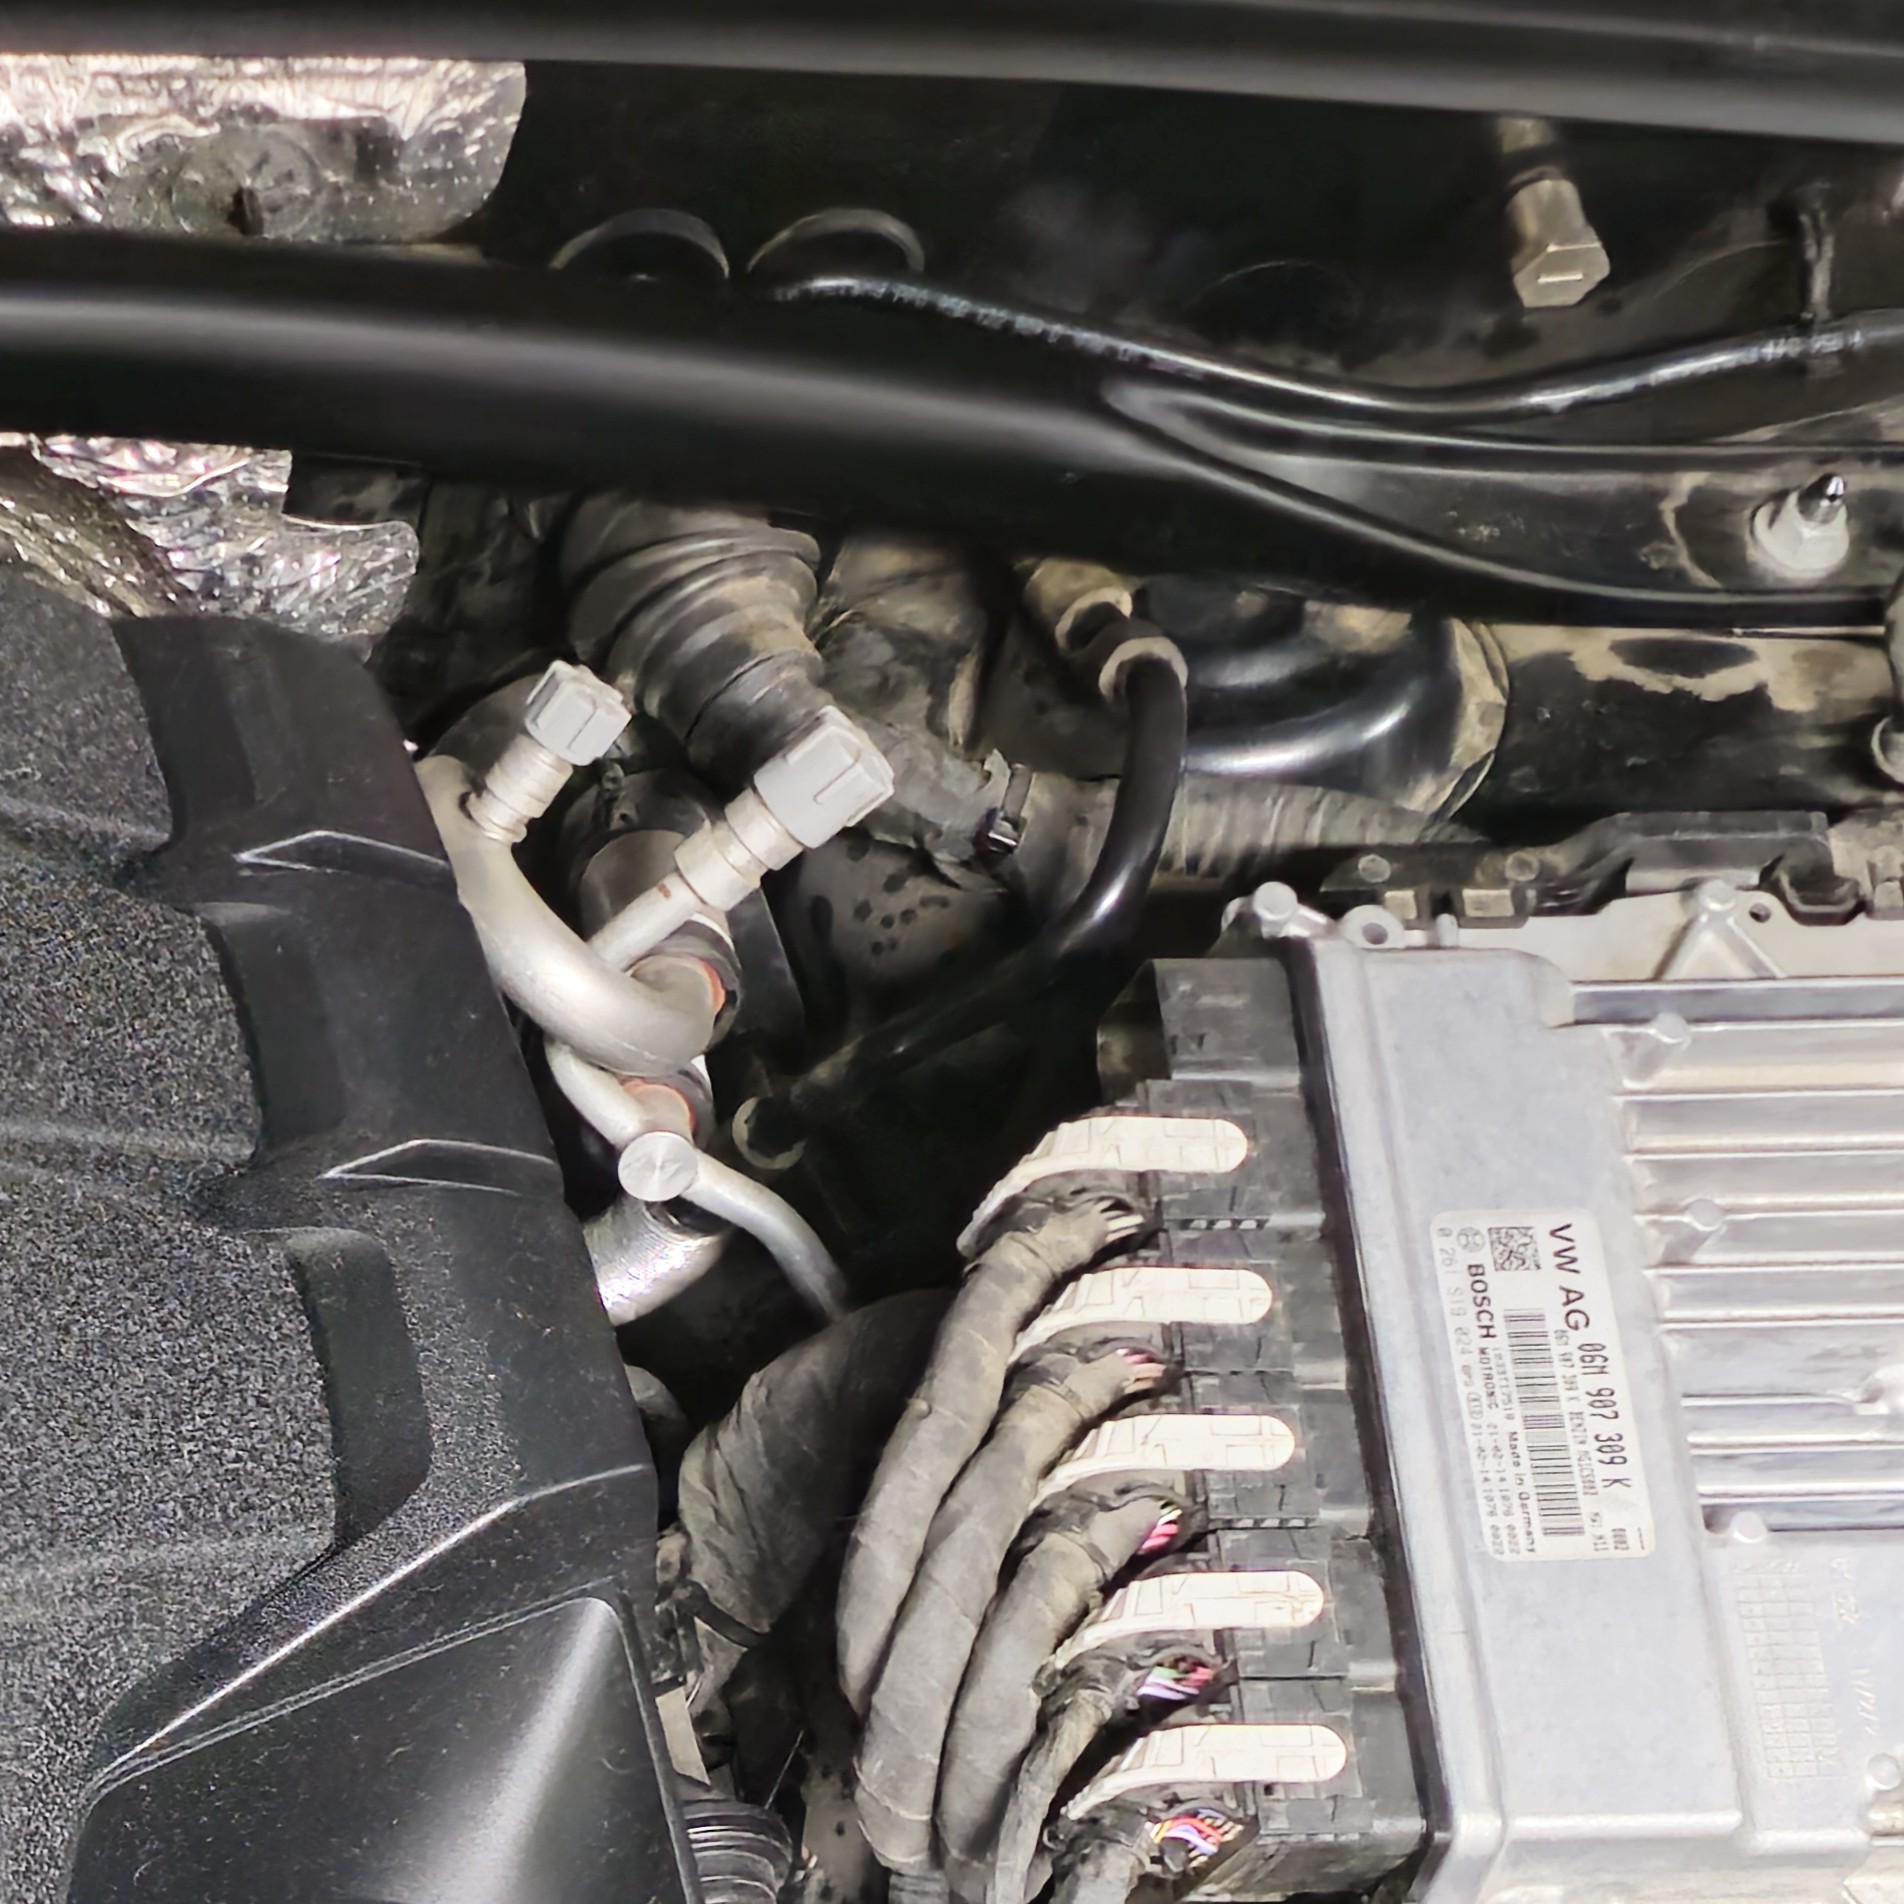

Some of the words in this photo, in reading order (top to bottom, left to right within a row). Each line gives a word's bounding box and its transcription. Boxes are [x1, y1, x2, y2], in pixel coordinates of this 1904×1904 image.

[1547, 1223, 1581, 1273] VW
[1467, 1263, 1496, 1339] BOSCH
[1558, 1283, 1590, 1331] AG
[1576, 1341, 1610, 1375] 06M
[1586, 1387, 1619, 1419] 907
[1506, 1430, 1523, 1466] Made
[1594, 1431, 1627, 1465] 309
[1514, 1472, 1527, 1485] in
[1602, 1477, 1631, 1489] K
[1517, 1491, 1537, 1553] Germany
